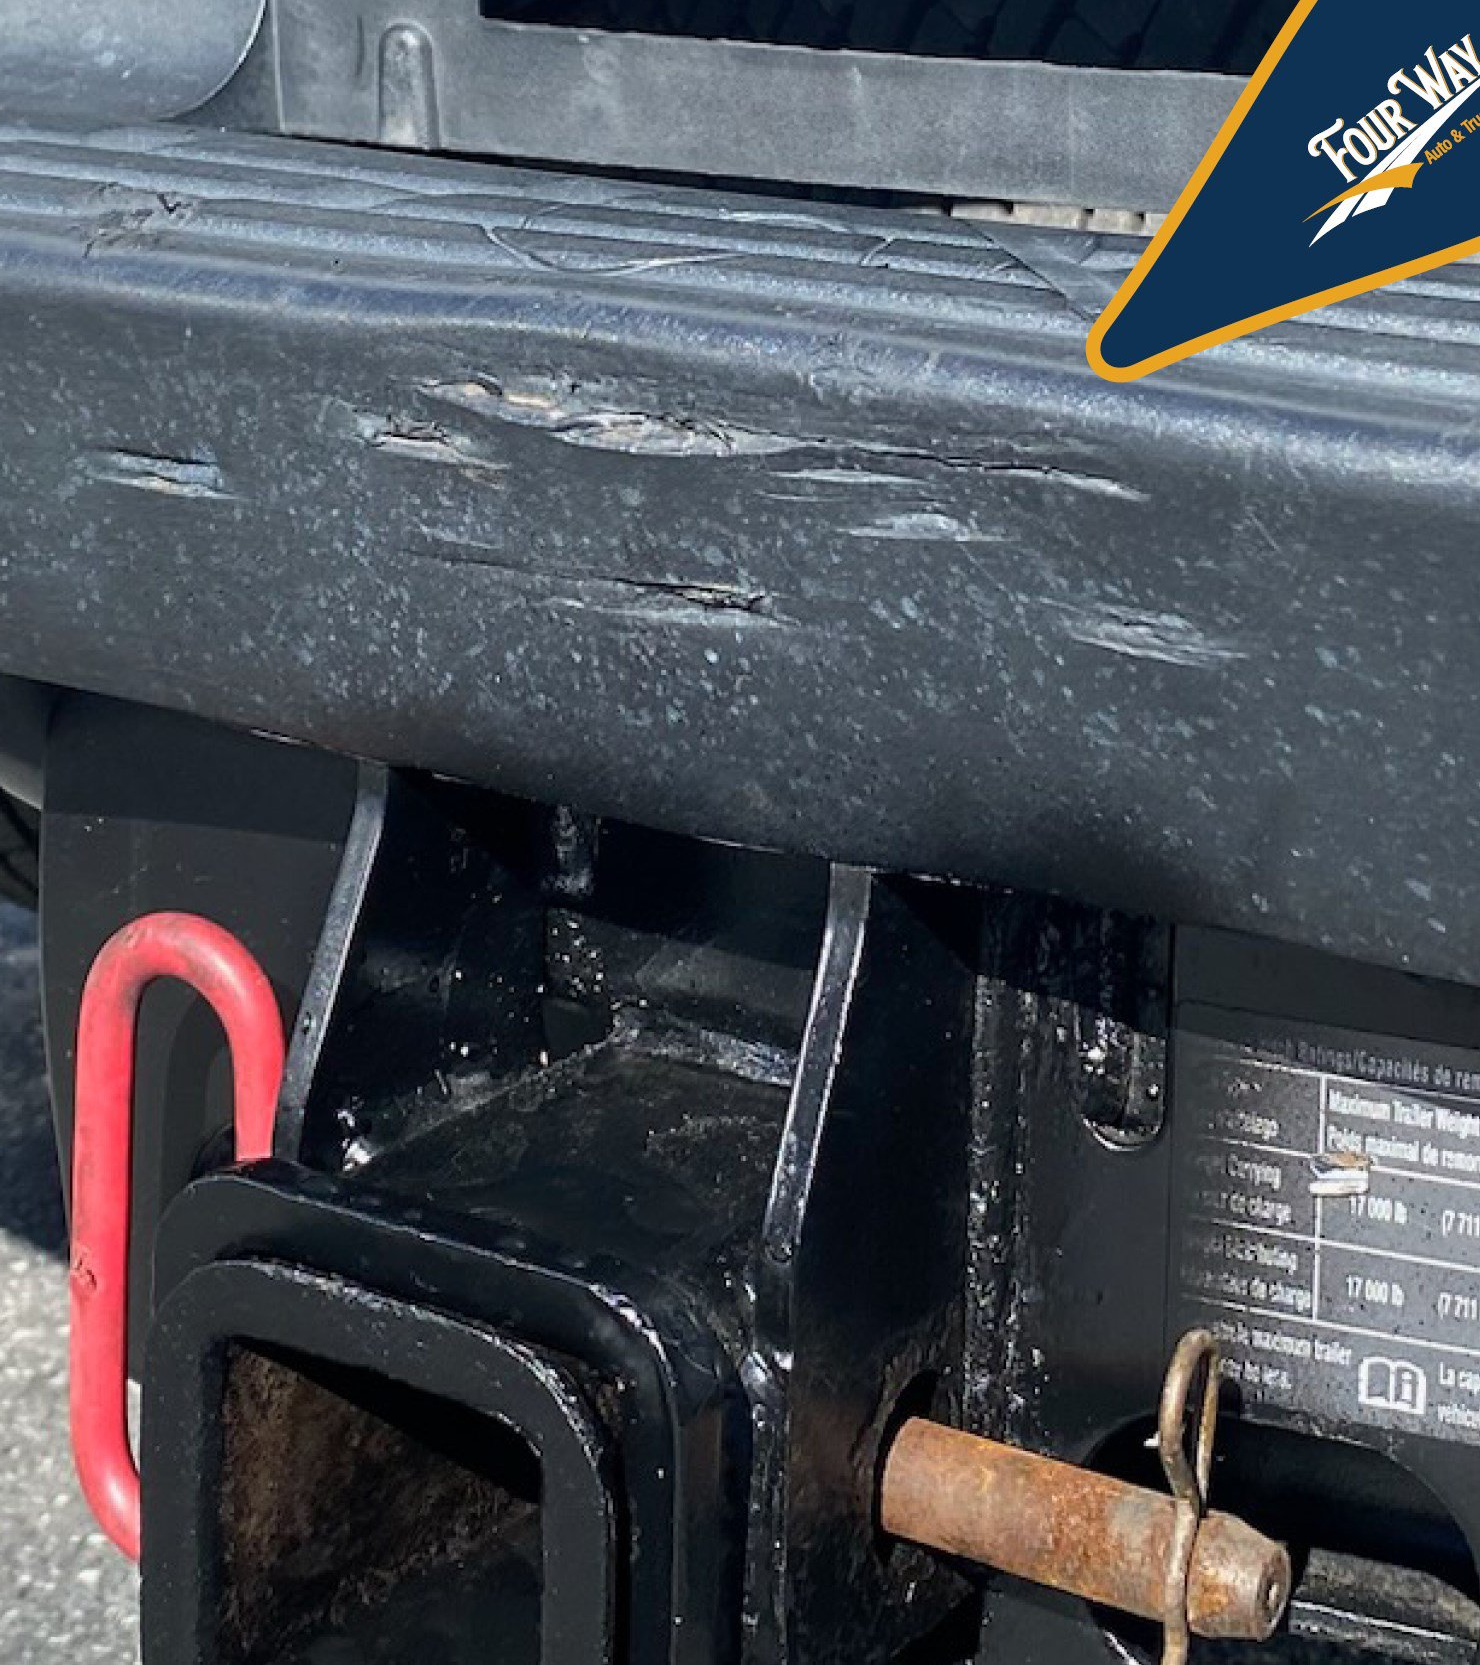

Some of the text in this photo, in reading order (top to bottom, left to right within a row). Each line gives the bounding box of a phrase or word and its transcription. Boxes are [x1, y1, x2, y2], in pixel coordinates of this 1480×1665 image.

[1432, 1062, 1451, 1086] de
[1329, 1089, 1389, 1119] Maximum
[1435, 1106, 1480, 1139] Weight
[1423, 1141, 1438, 1165] de
[1350, 1195, 1366, 1217] 17
[1457, 1212, 1480, 1238] 711
[1345, 1274, 1363, 1298] 17
[1439, 1361, 1455, 1386] La
